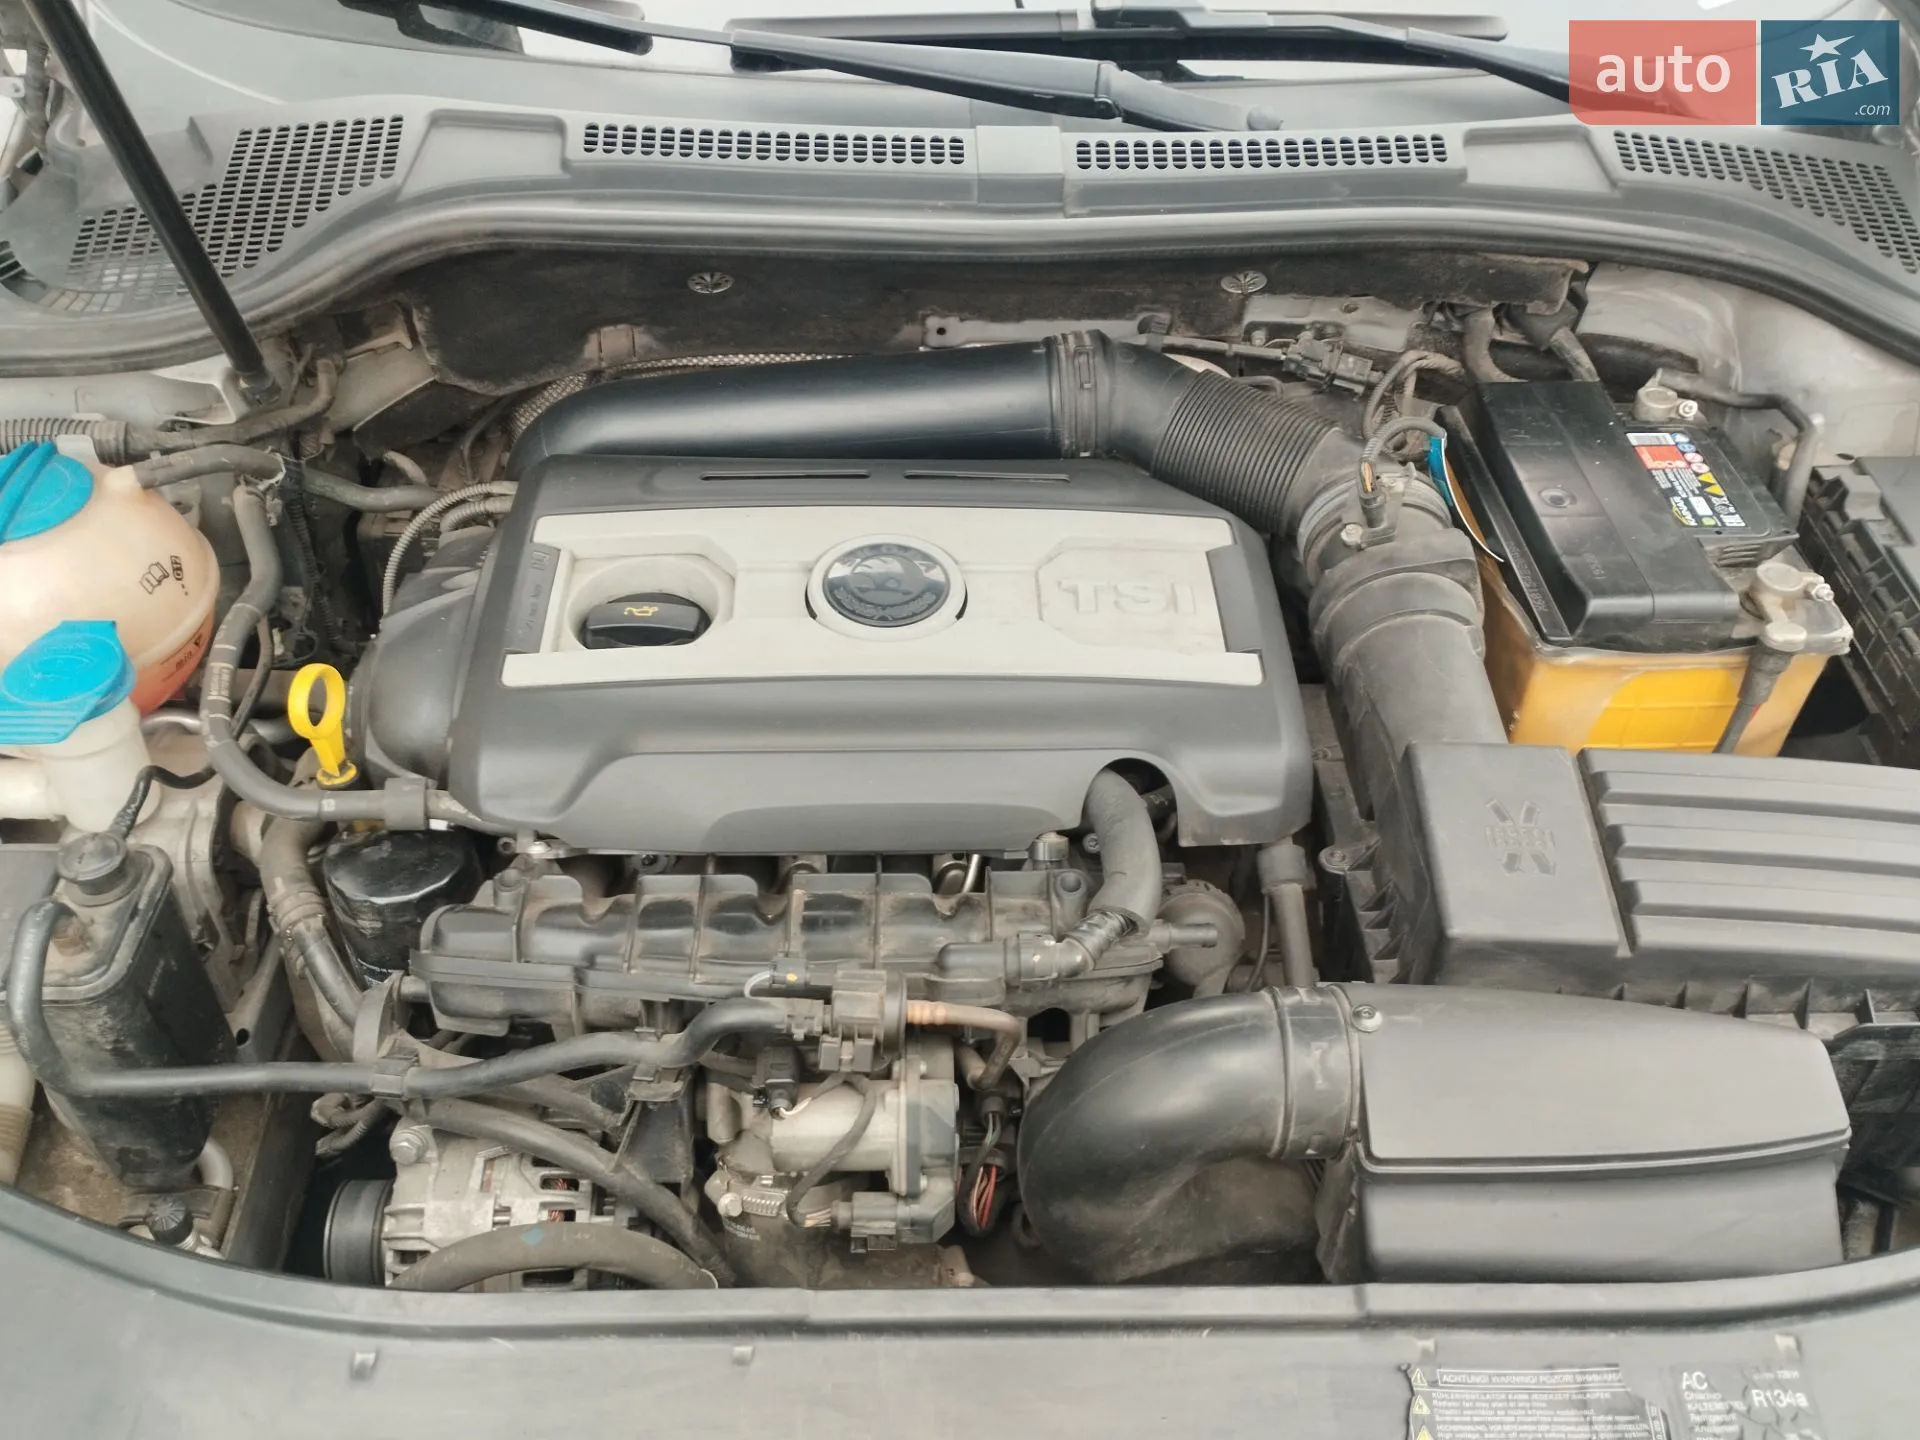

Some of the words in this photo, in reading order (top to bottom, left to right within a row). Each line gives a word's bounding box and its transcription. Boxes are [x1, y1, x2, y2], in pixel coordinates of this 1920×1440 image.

[1057, 578, 1197, 614] TSI
[1682, 1371, 1708, 1390] AC
[1751, 1389, 1809, 1408] R134a
